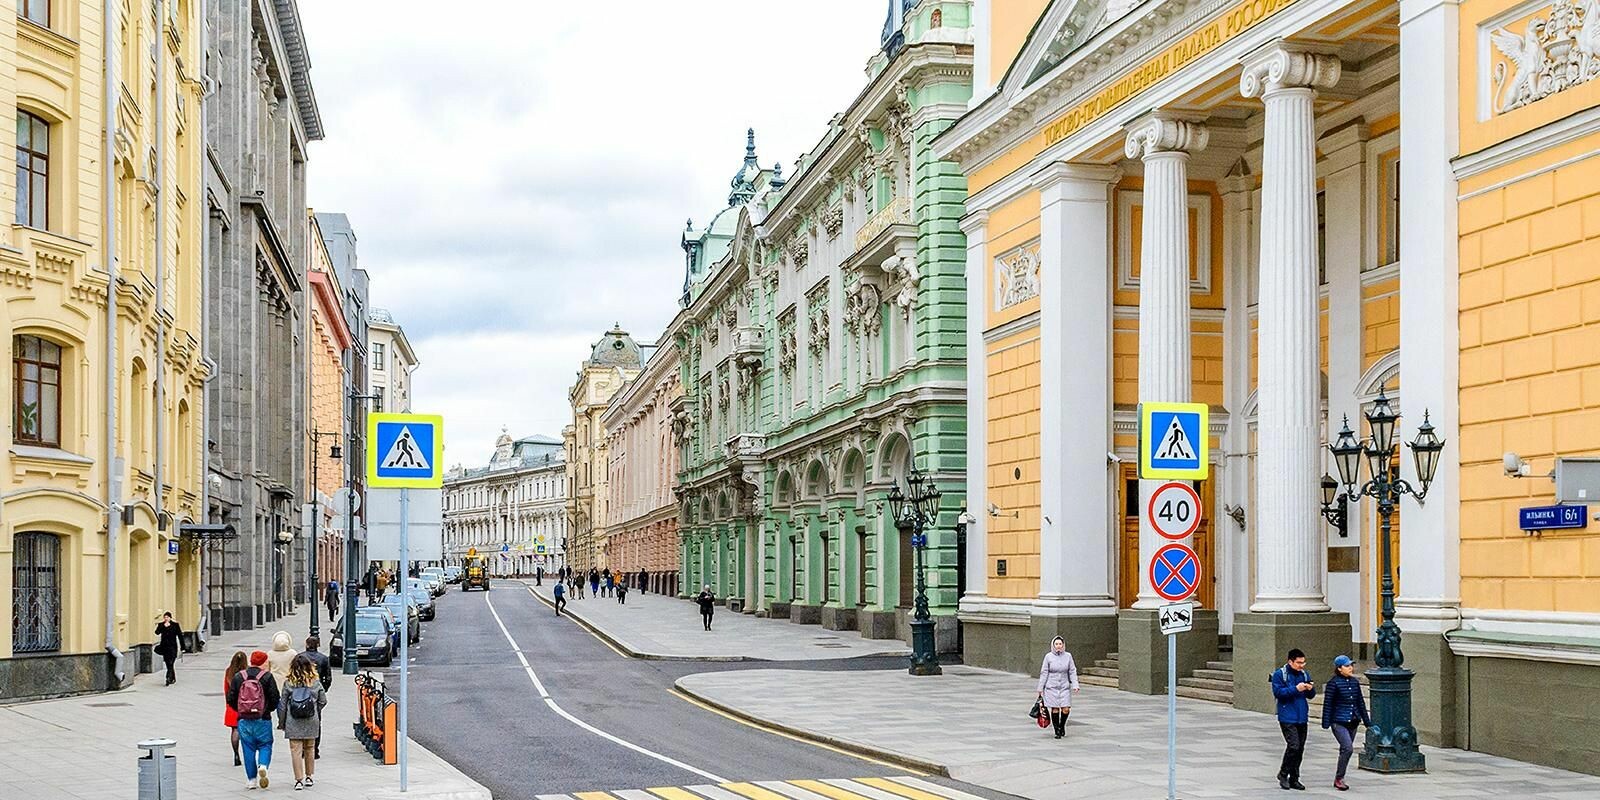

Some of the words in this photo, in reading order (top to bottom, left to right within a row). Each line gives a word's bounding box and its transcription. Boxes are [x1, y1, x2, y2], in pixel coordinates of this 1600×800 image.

[1173, 23, 1221, 69] ПАЛАТА
[1159, 500, 1190, 522] 40
[1565, 509, 1577, 520] 6/1
